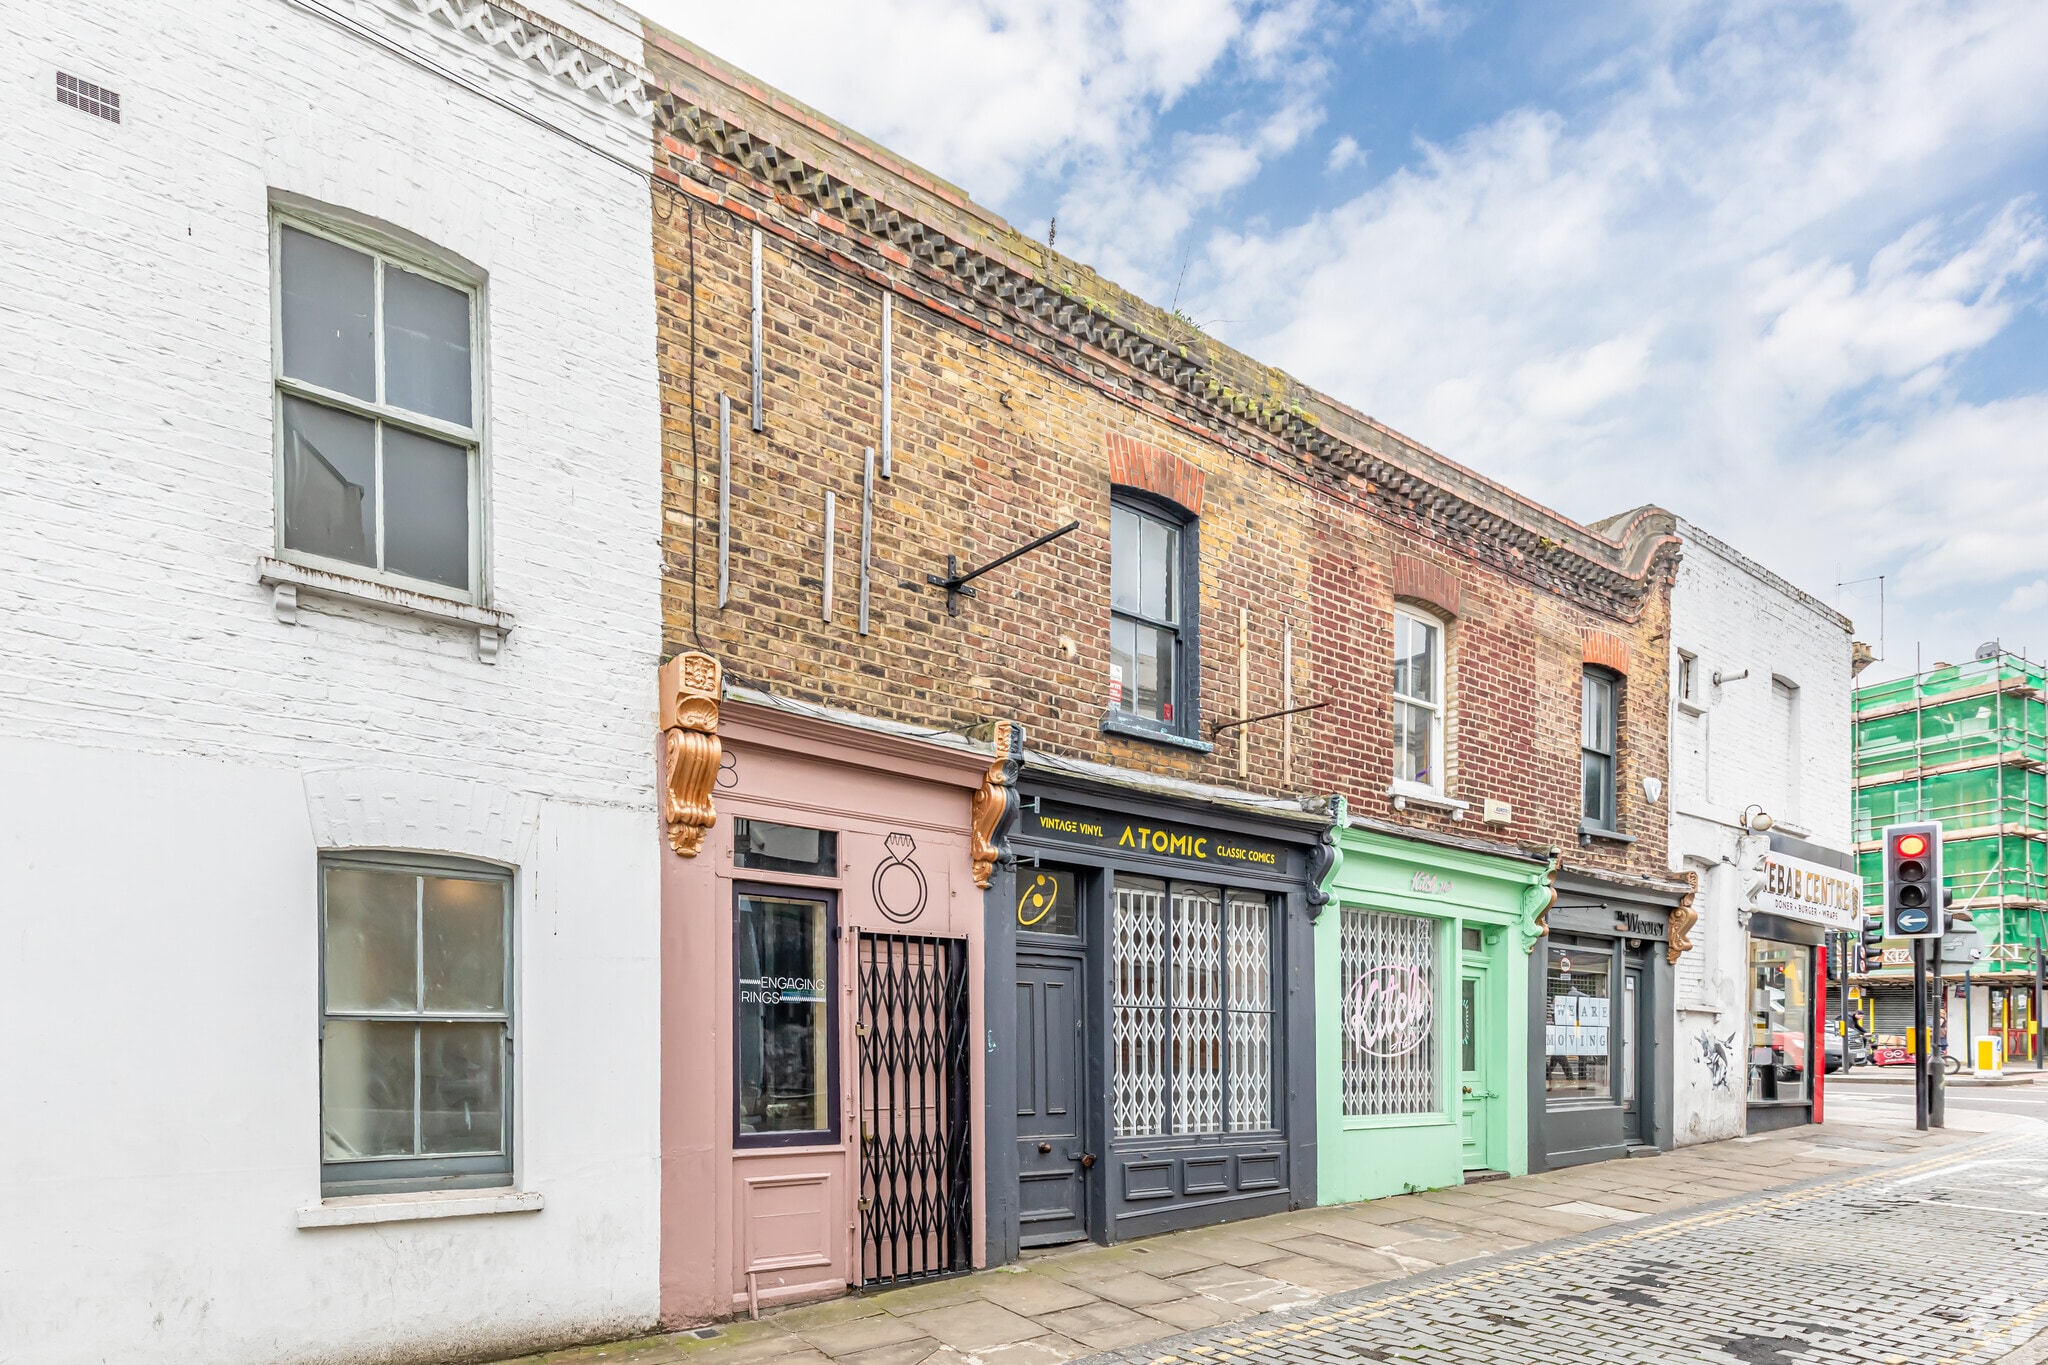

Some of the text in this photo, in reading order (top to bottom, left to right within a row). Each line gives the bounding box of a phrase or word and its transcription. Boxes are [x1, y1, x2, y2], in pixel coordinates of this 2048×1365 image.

[1040, 816, 1103, 837] VINTAGE VINYL
[1118, 825, 1208, 859] ATOMIC
[1216, 845, 1275, 864] CLASSIC COMICS
[1804, 871, 1850, 911] CENTRE
[1775, 899, 1839, 920] DONER BURGER WRAPS
[761, 976, 825, 991] ENGAGING
[741, 988, 780, 1004] RINGS
[1351, 964, 1426, 1054] Kitch
[1556, 1004, 1608, 1018] WE ARE
[1546, 1034, 1606, 1047] MOVING
